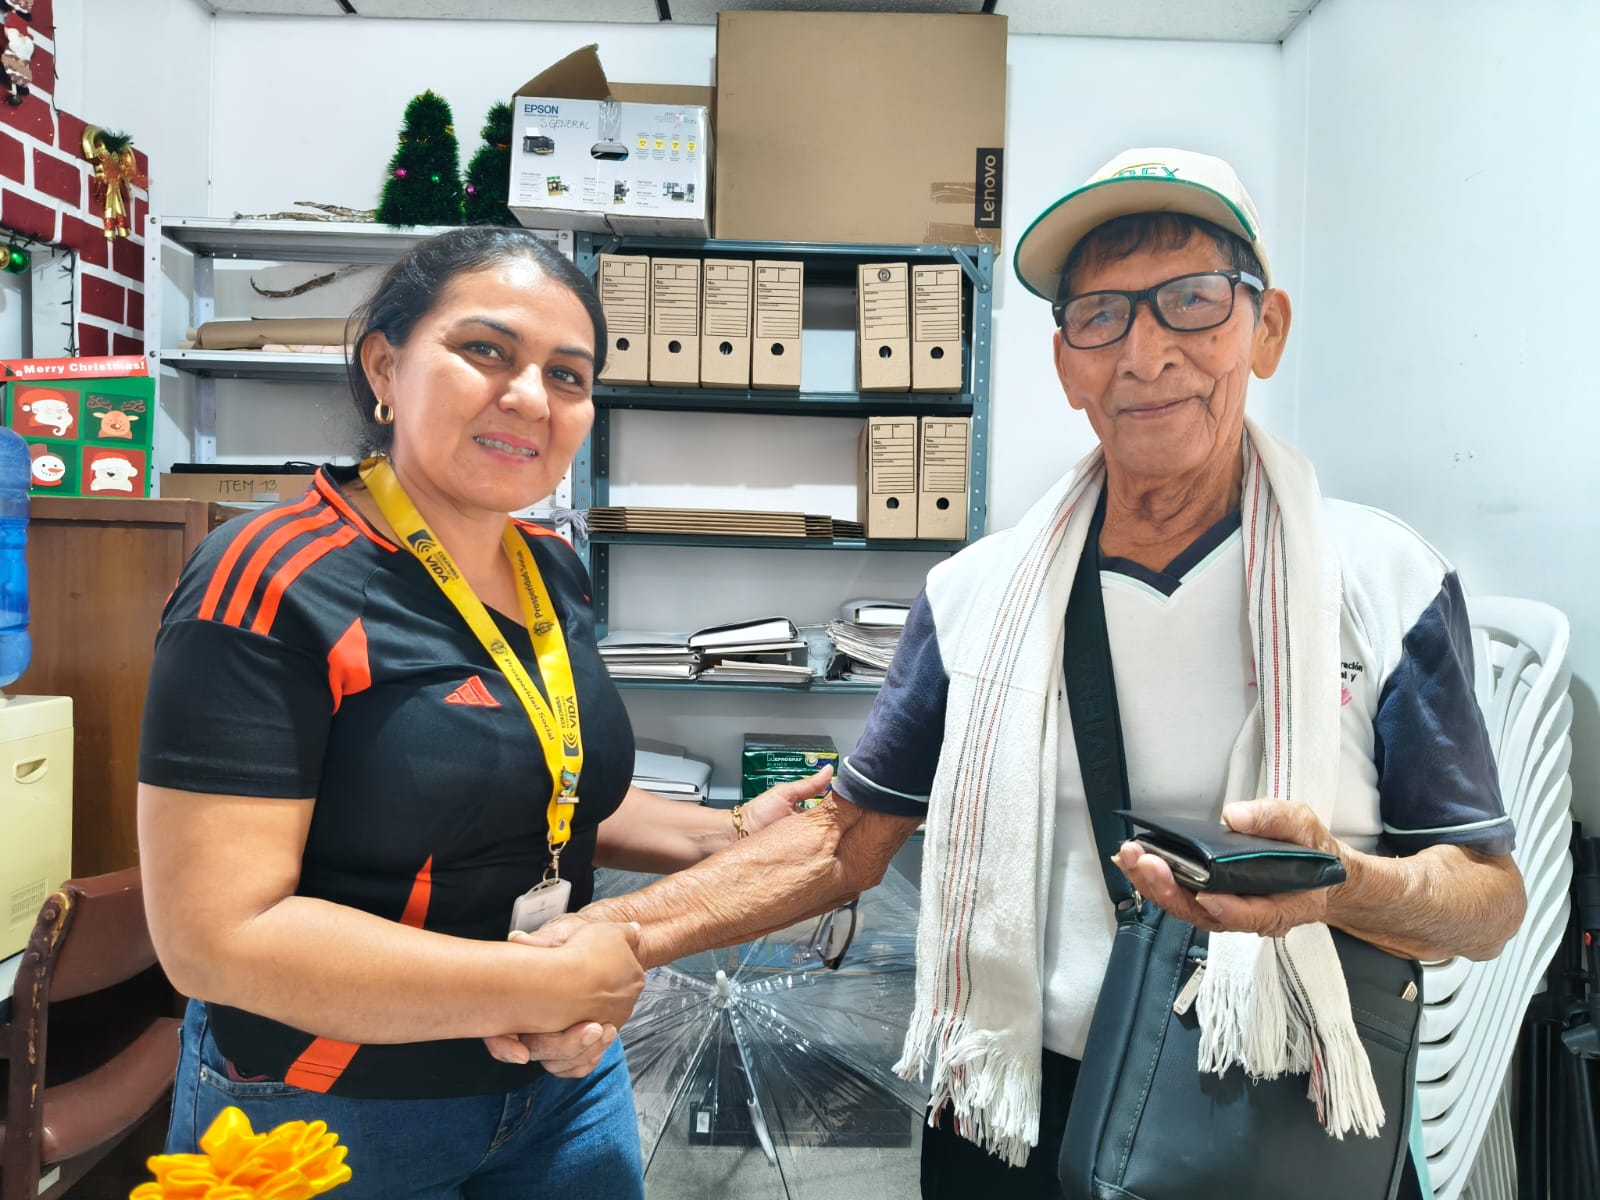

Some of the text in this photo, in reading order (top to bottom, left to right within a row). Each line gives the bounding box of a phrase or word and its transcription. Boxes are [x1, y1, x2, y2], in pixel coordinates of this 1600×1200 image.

[523, 103, 559, 114] EPSON
[980, 155, 997, 222] Lenovo
[23, 361, 145, 375] Merry Christmas!
[219, 480, 277, 493] ITEM 13
[425, 555, 448, 583] VIDA
[504, 659, 555, 740] Prosperidad Social
[566, 696, 577, 728] VIDA
